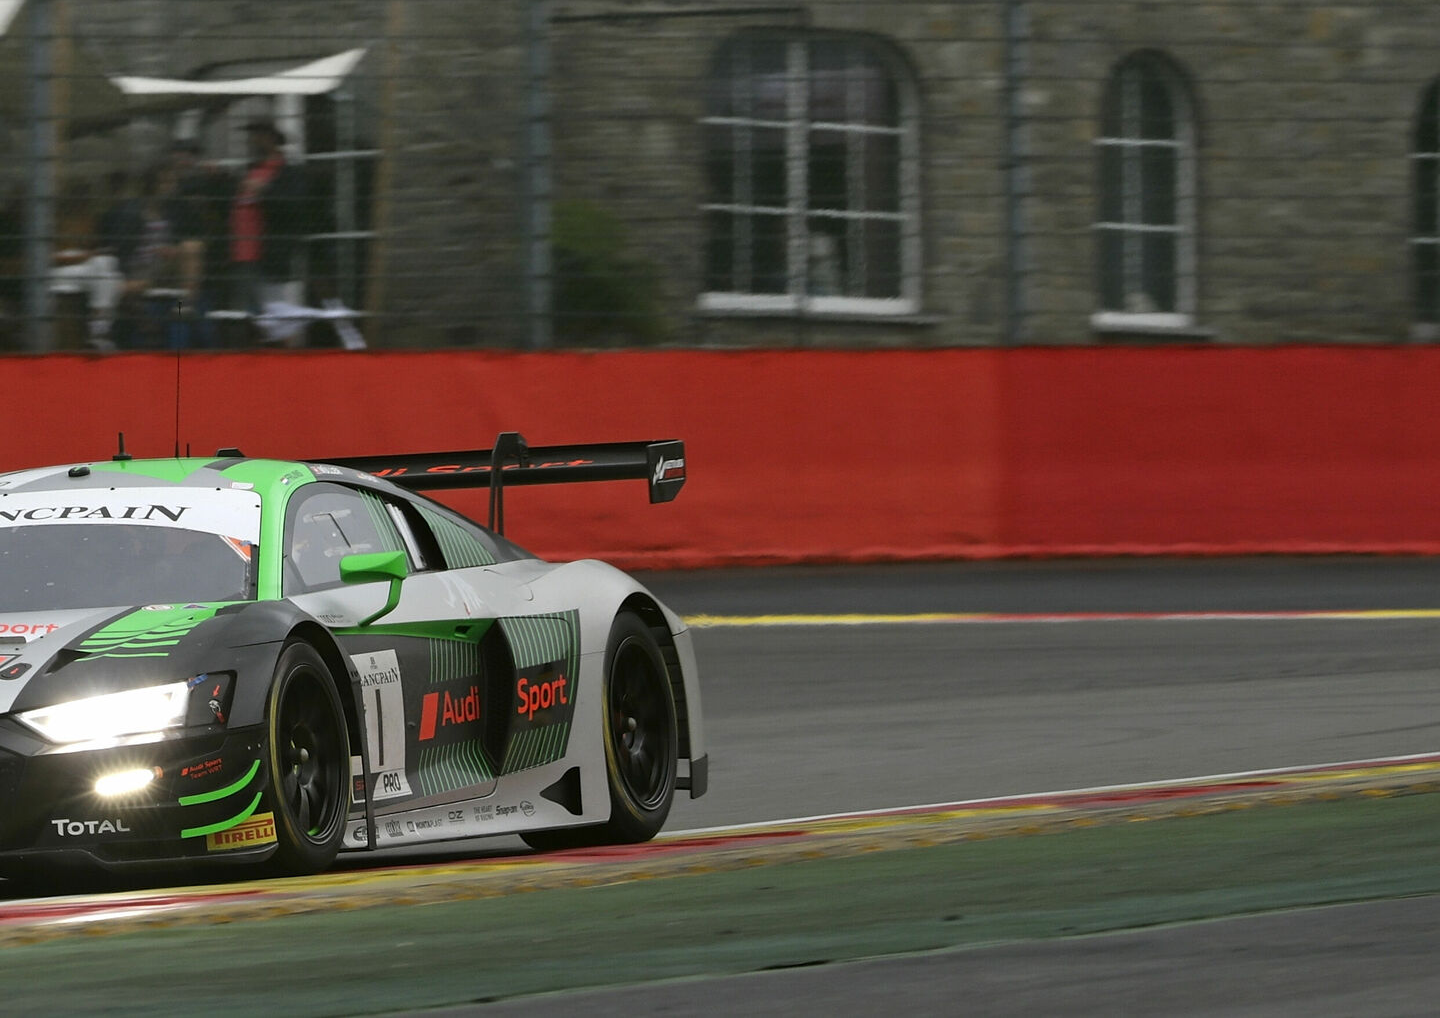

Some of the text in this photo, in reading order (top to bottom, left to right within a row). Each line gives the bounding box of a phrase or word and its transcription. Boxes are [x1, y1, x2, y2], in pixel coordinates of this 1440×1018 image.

[442, 674, 567, 726] Audi Sport
[383, 772, 401, 793] PRO
[51, 818, 130, 837] TOTAL
